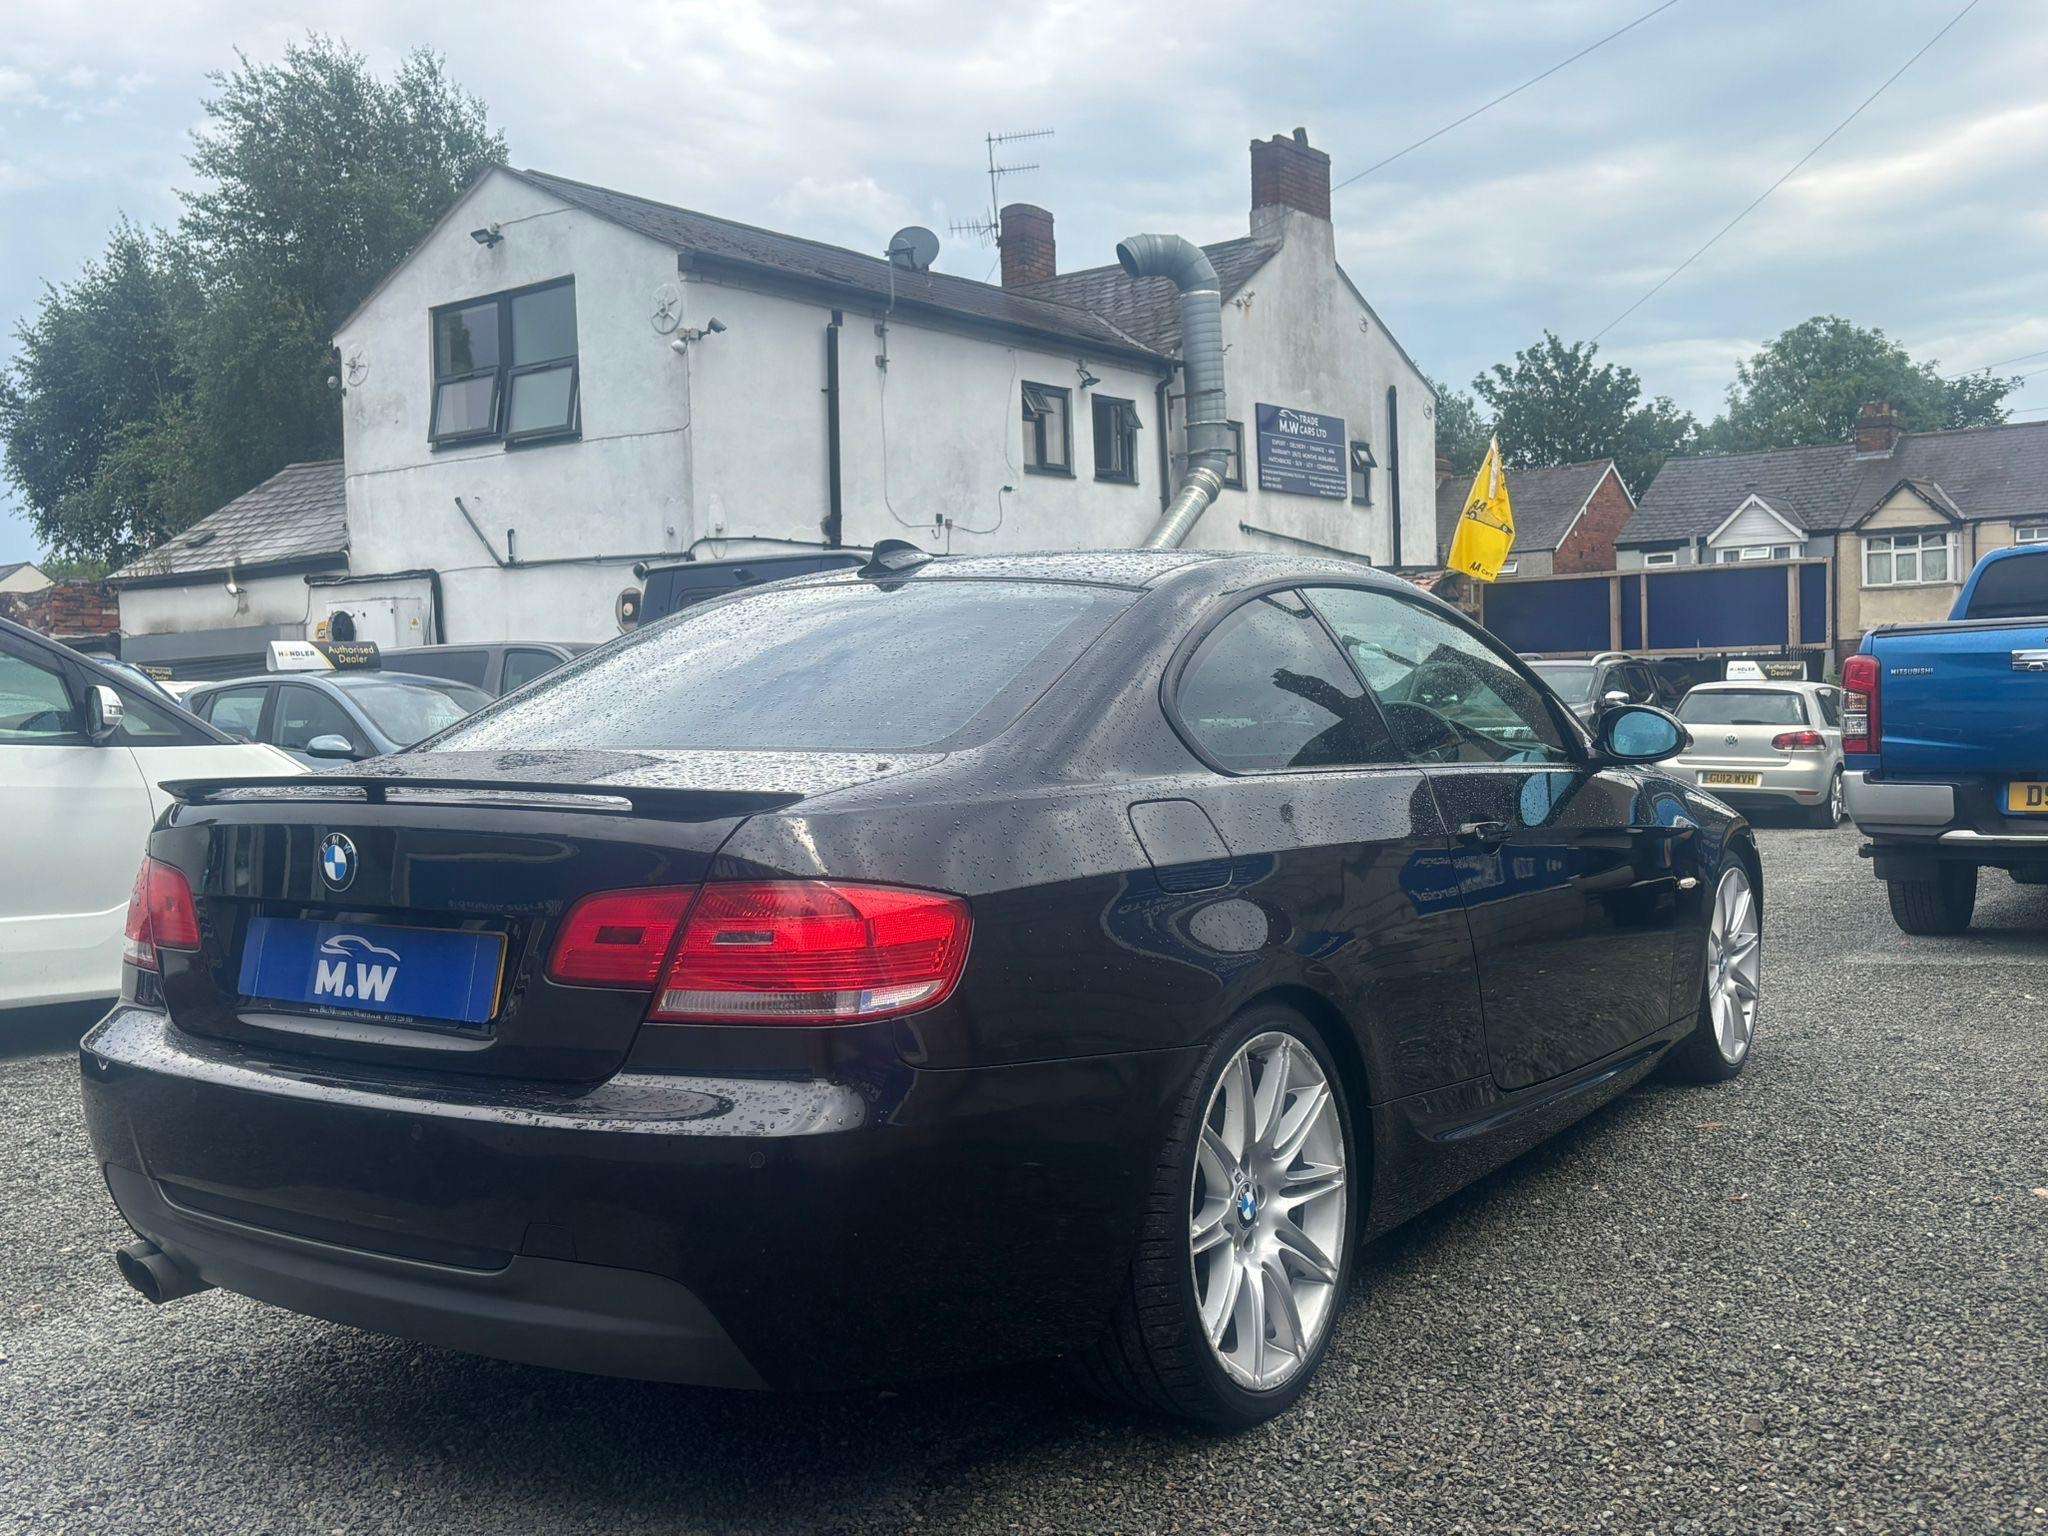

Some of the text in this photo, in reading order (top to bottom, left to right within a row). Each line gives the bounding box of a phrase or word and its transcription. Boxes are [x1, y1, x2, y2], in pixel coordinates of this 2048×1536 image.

[1299, 414, 1319, 427] TRADE
[1279, 419, 1299, 435] M.W
[1300, 425, 1327, 438] CARS LTD
[1469, 561, 1482, 573] AA
[328, 645, 375, 655] Authorised
[338, 654, 368, 664] Dealer
[1770, 669, 1793, 677] Dealer
[1890, 667, 1934, 675] MITSUBISHI
[1709, 773, 1732, 784] GU12
[314, 959, 398, 1002] M.W
